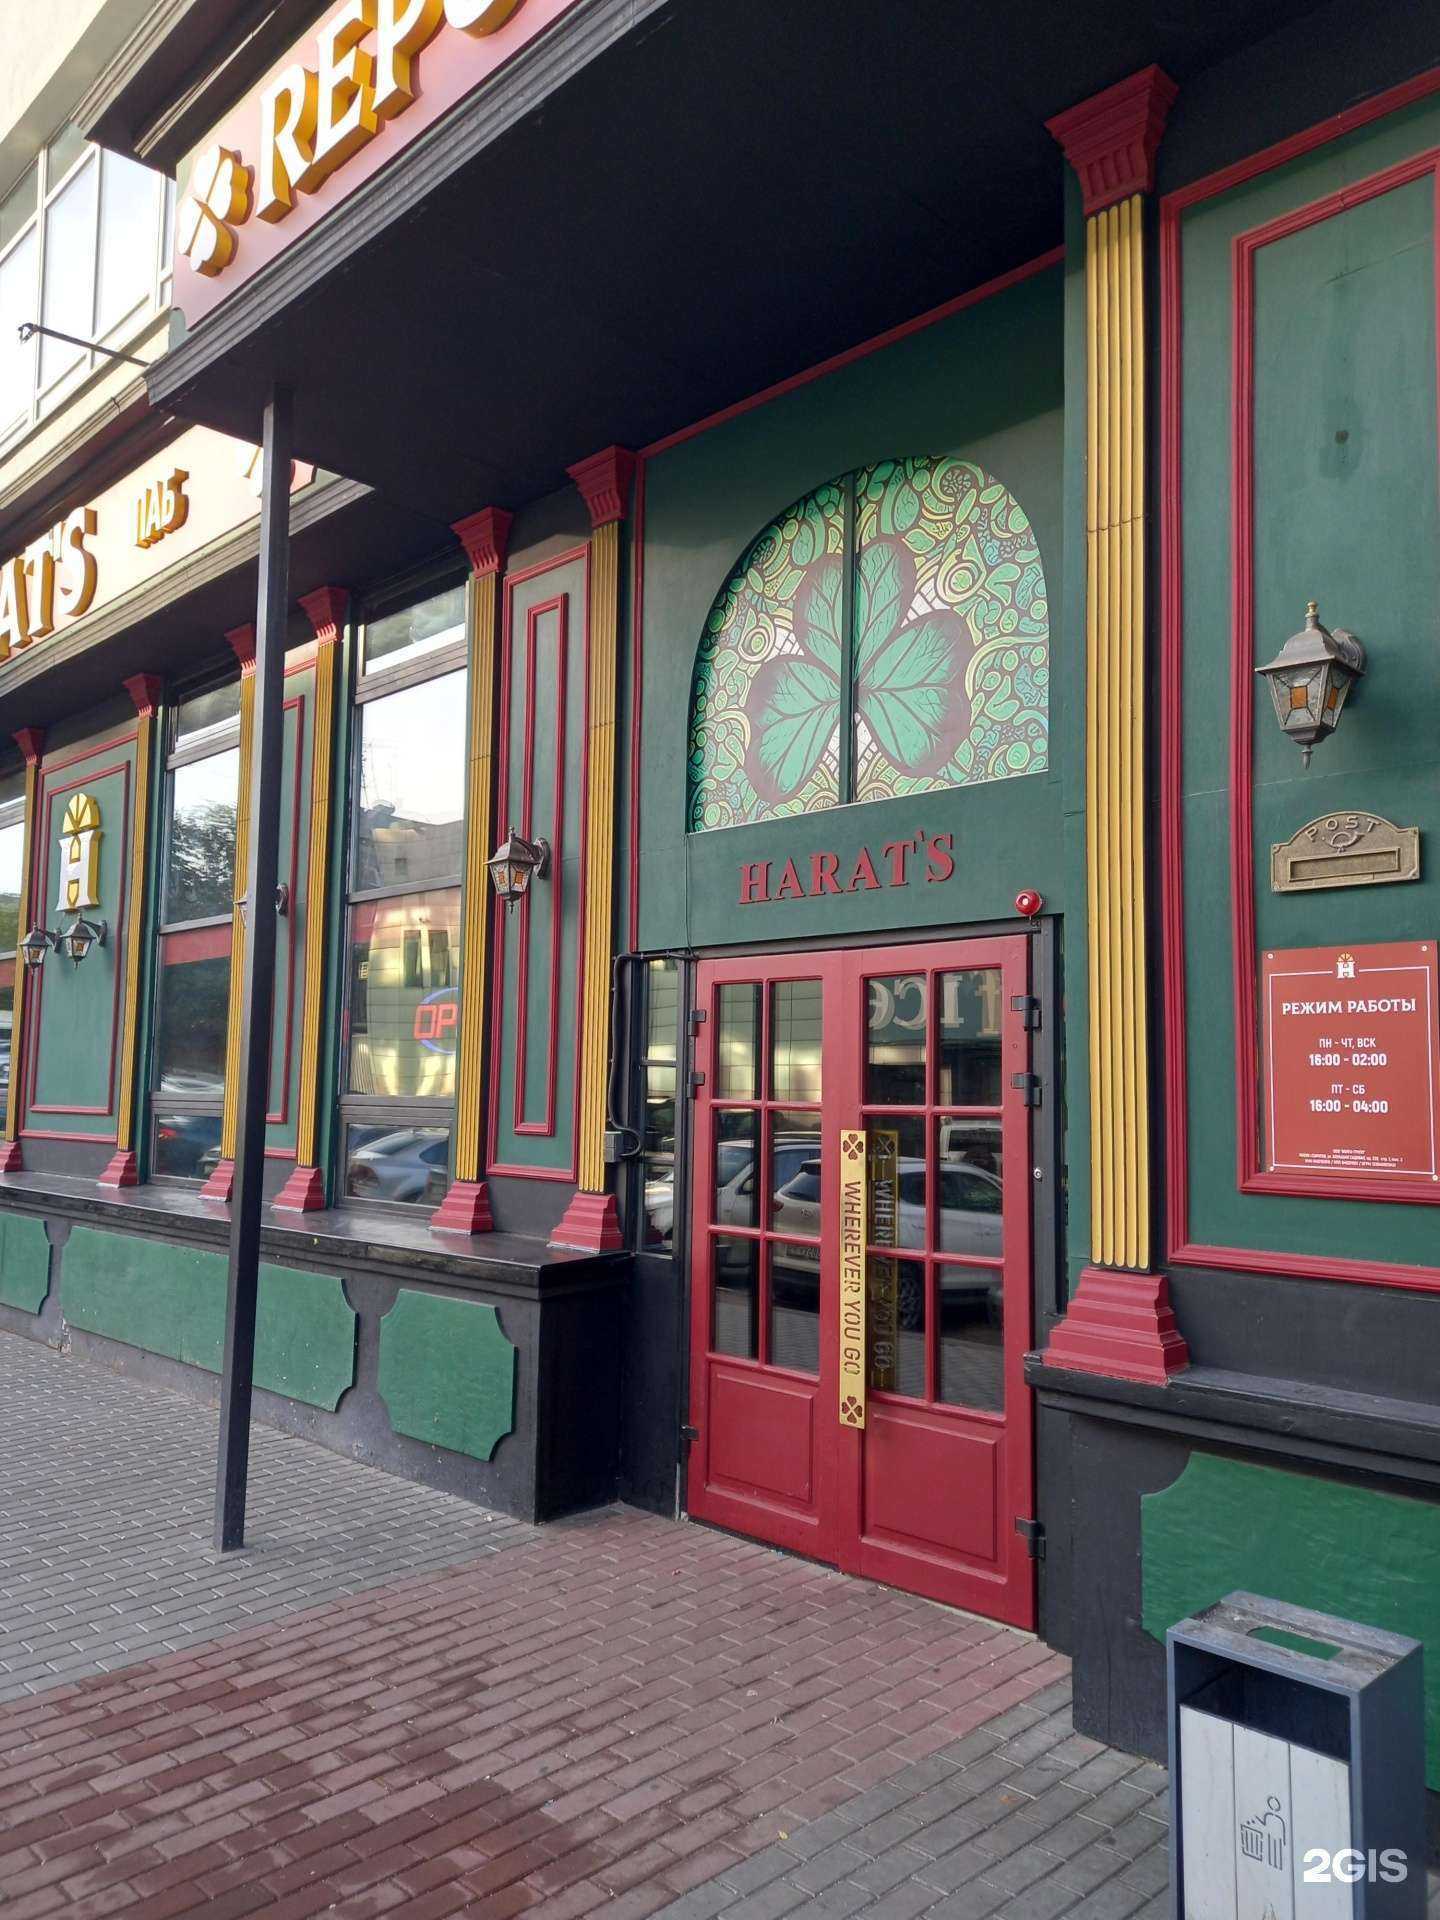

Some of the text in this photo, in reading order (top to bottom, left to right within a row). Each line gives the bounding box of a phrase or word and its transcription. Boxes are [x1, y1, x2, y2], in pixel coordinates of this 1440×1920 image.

[256, 0, 520, 222] REP
[1305, 815, 1381, 843] POST
[737, 828, 955, 905] HARAT'S
[1282, 998, 1417, 1015] РЕЖИМ РАБОТЫ
[1319, 1038, 1332, 1048] ПН
[1341, 1038, 1355, 1049] ЧТ,
[1357, 1037, 1377, 1048] ВСК
[1309, 1054, 1340, 1066] 16:00
[1352, 1053, 1387, 1066] 02:00
[1331, 1084, 1343, 1094] ПТ
[1352, 1084, 1366, 1094] СБ
[1310, 1099, 1341, 1112] 16:00
[1353, 1100, 1388, 1113] 04:00
[844, 1181, 861, 1375] WHEREVER YOU GO
